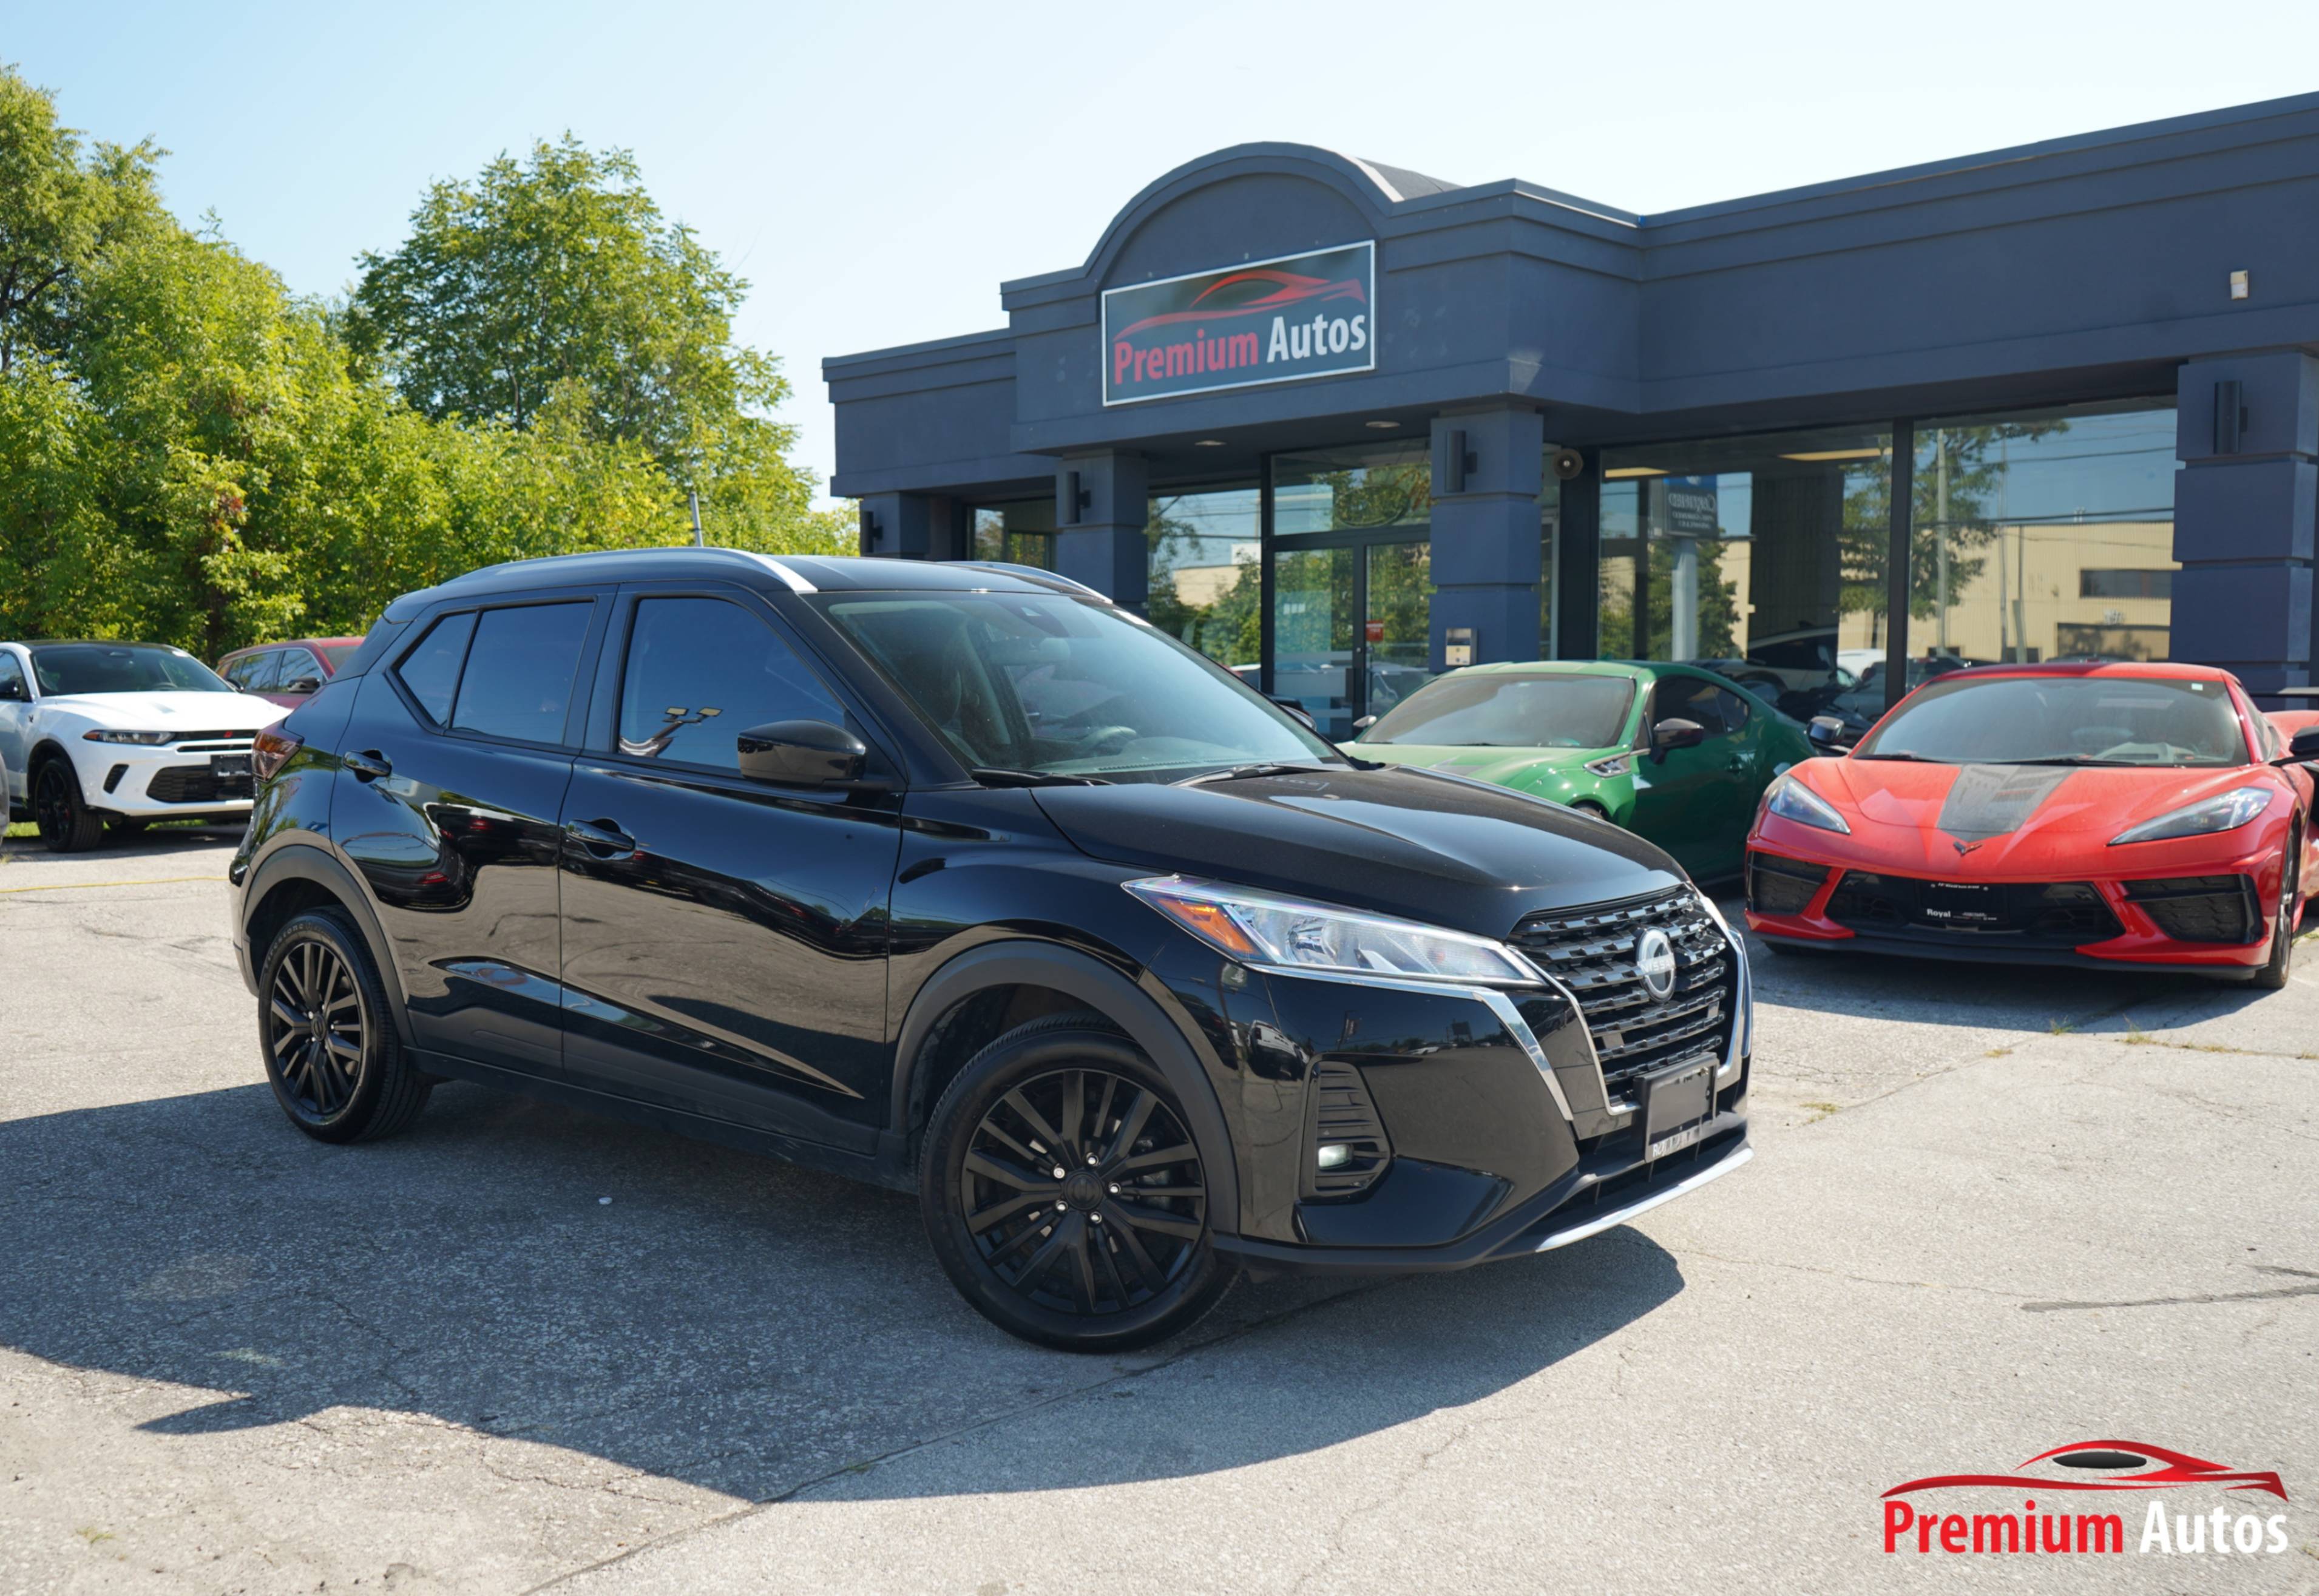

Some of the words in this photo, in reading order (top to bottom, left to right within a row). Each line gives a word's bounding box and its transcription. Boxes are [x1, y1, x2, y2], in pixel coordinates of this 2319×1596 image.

[1114, 328, 1259, 385] Premium
[1267, 313, 1367, 363] Autos
[1926, 908, 1951, 918] Royal
